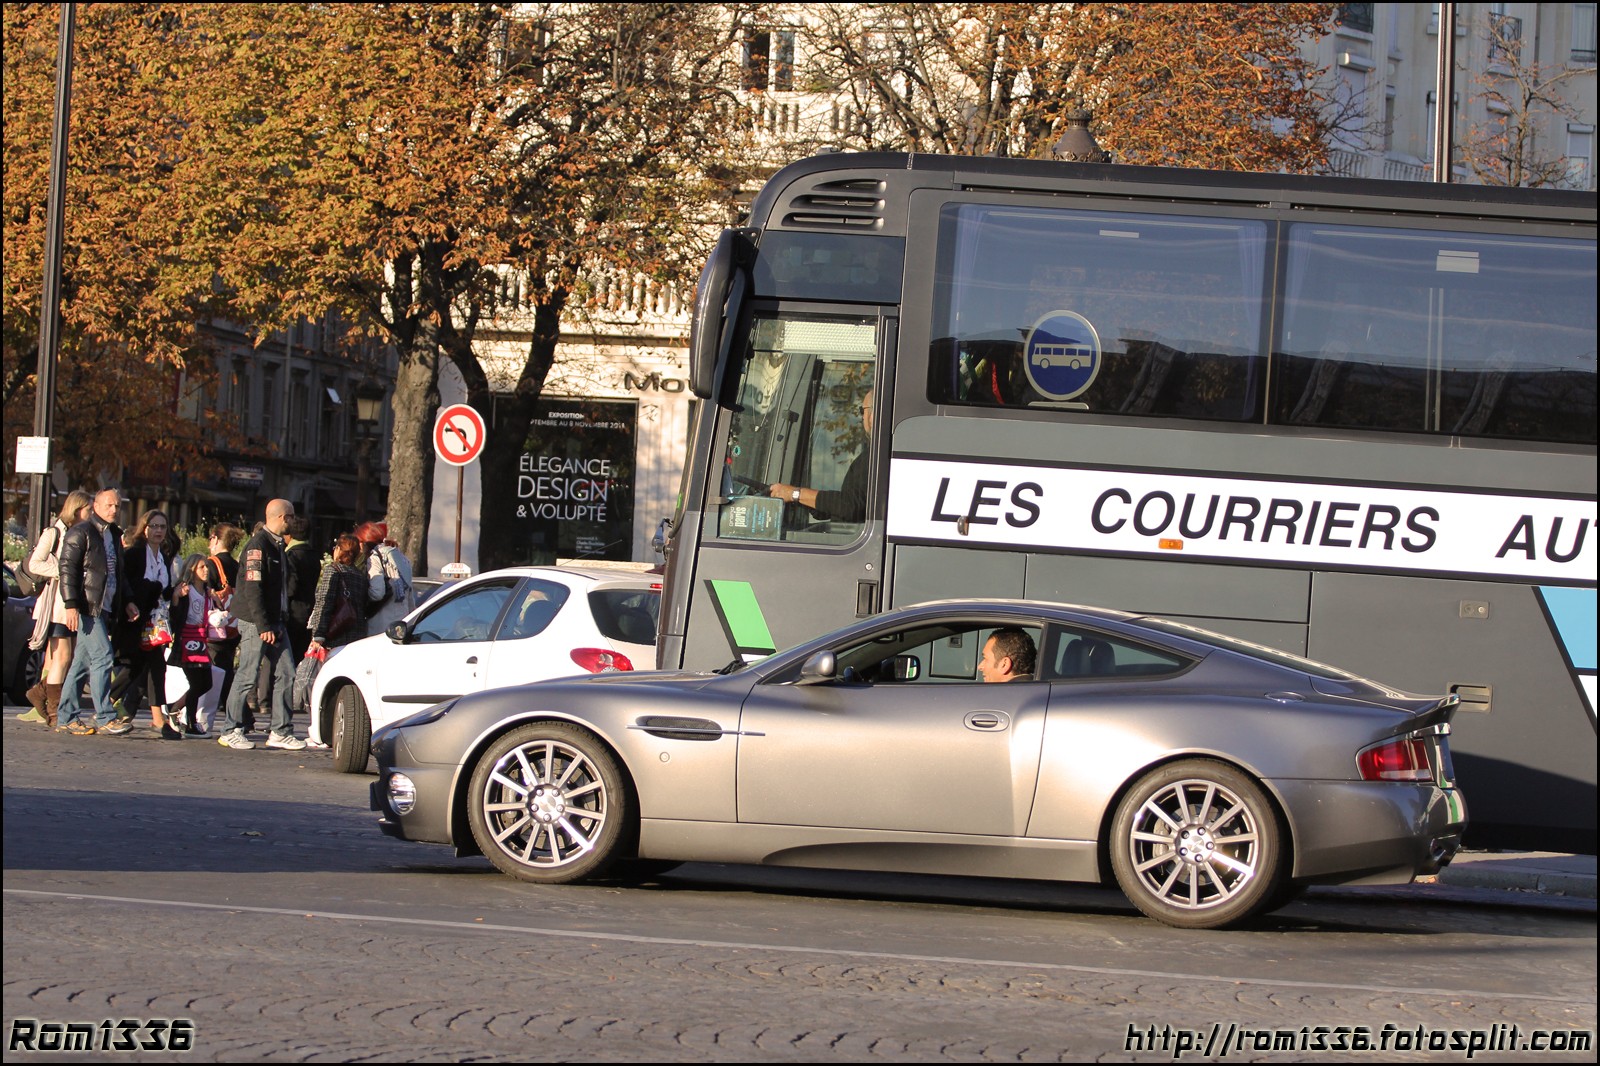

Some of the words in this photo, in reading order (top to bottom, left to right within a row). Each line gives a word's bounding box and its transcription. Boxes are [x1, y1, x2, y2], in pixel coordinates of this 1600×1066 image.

[624, 371, 695, 393] MO
[548, 411, 585, 420] EXPOSITION
[519, 452, 611, 476] ÉLEGANCE
[517, 475, 608, 502] DESIGN
[516, 504, 527, 518] &
[530, 502, 607, 522] VOLUPTÉ
[930, 477, 1044, 529] LES
[1090, 486, 1440, 554] COURRIERS
[1494, 514, 1597, 563] AU
